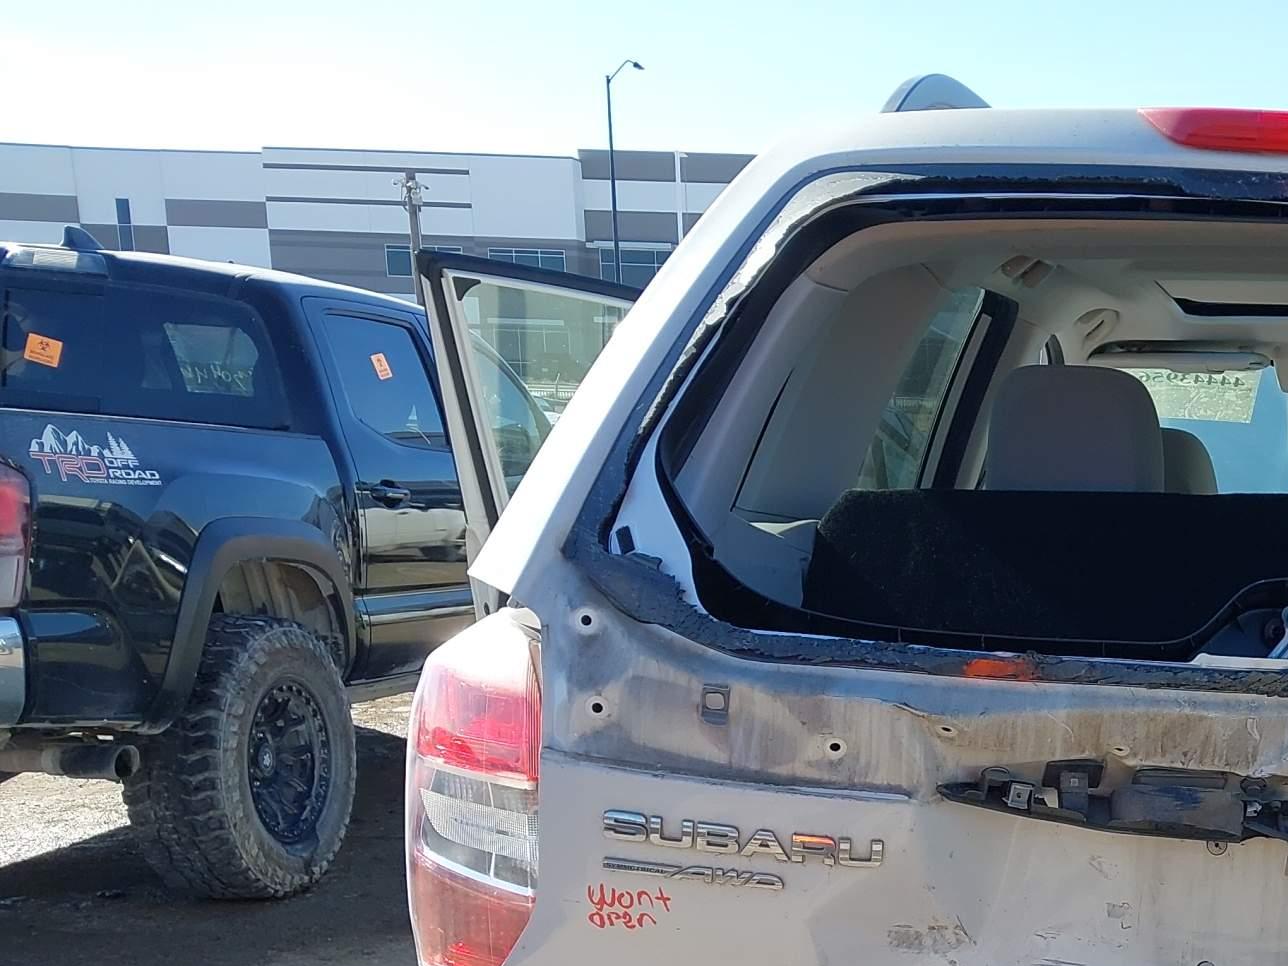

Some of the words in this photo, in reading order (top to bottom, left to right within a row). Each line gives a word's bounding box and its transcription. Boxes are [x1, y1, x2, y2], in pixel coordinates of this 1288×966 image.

[29, 451, 108, 483] TRD
[104, 457, 140, 468] OFF
[109, 469, 160, 480] ROAD
[603, 809, 885, 868] SUBARU
[666, 865, 785, 891] AWD
